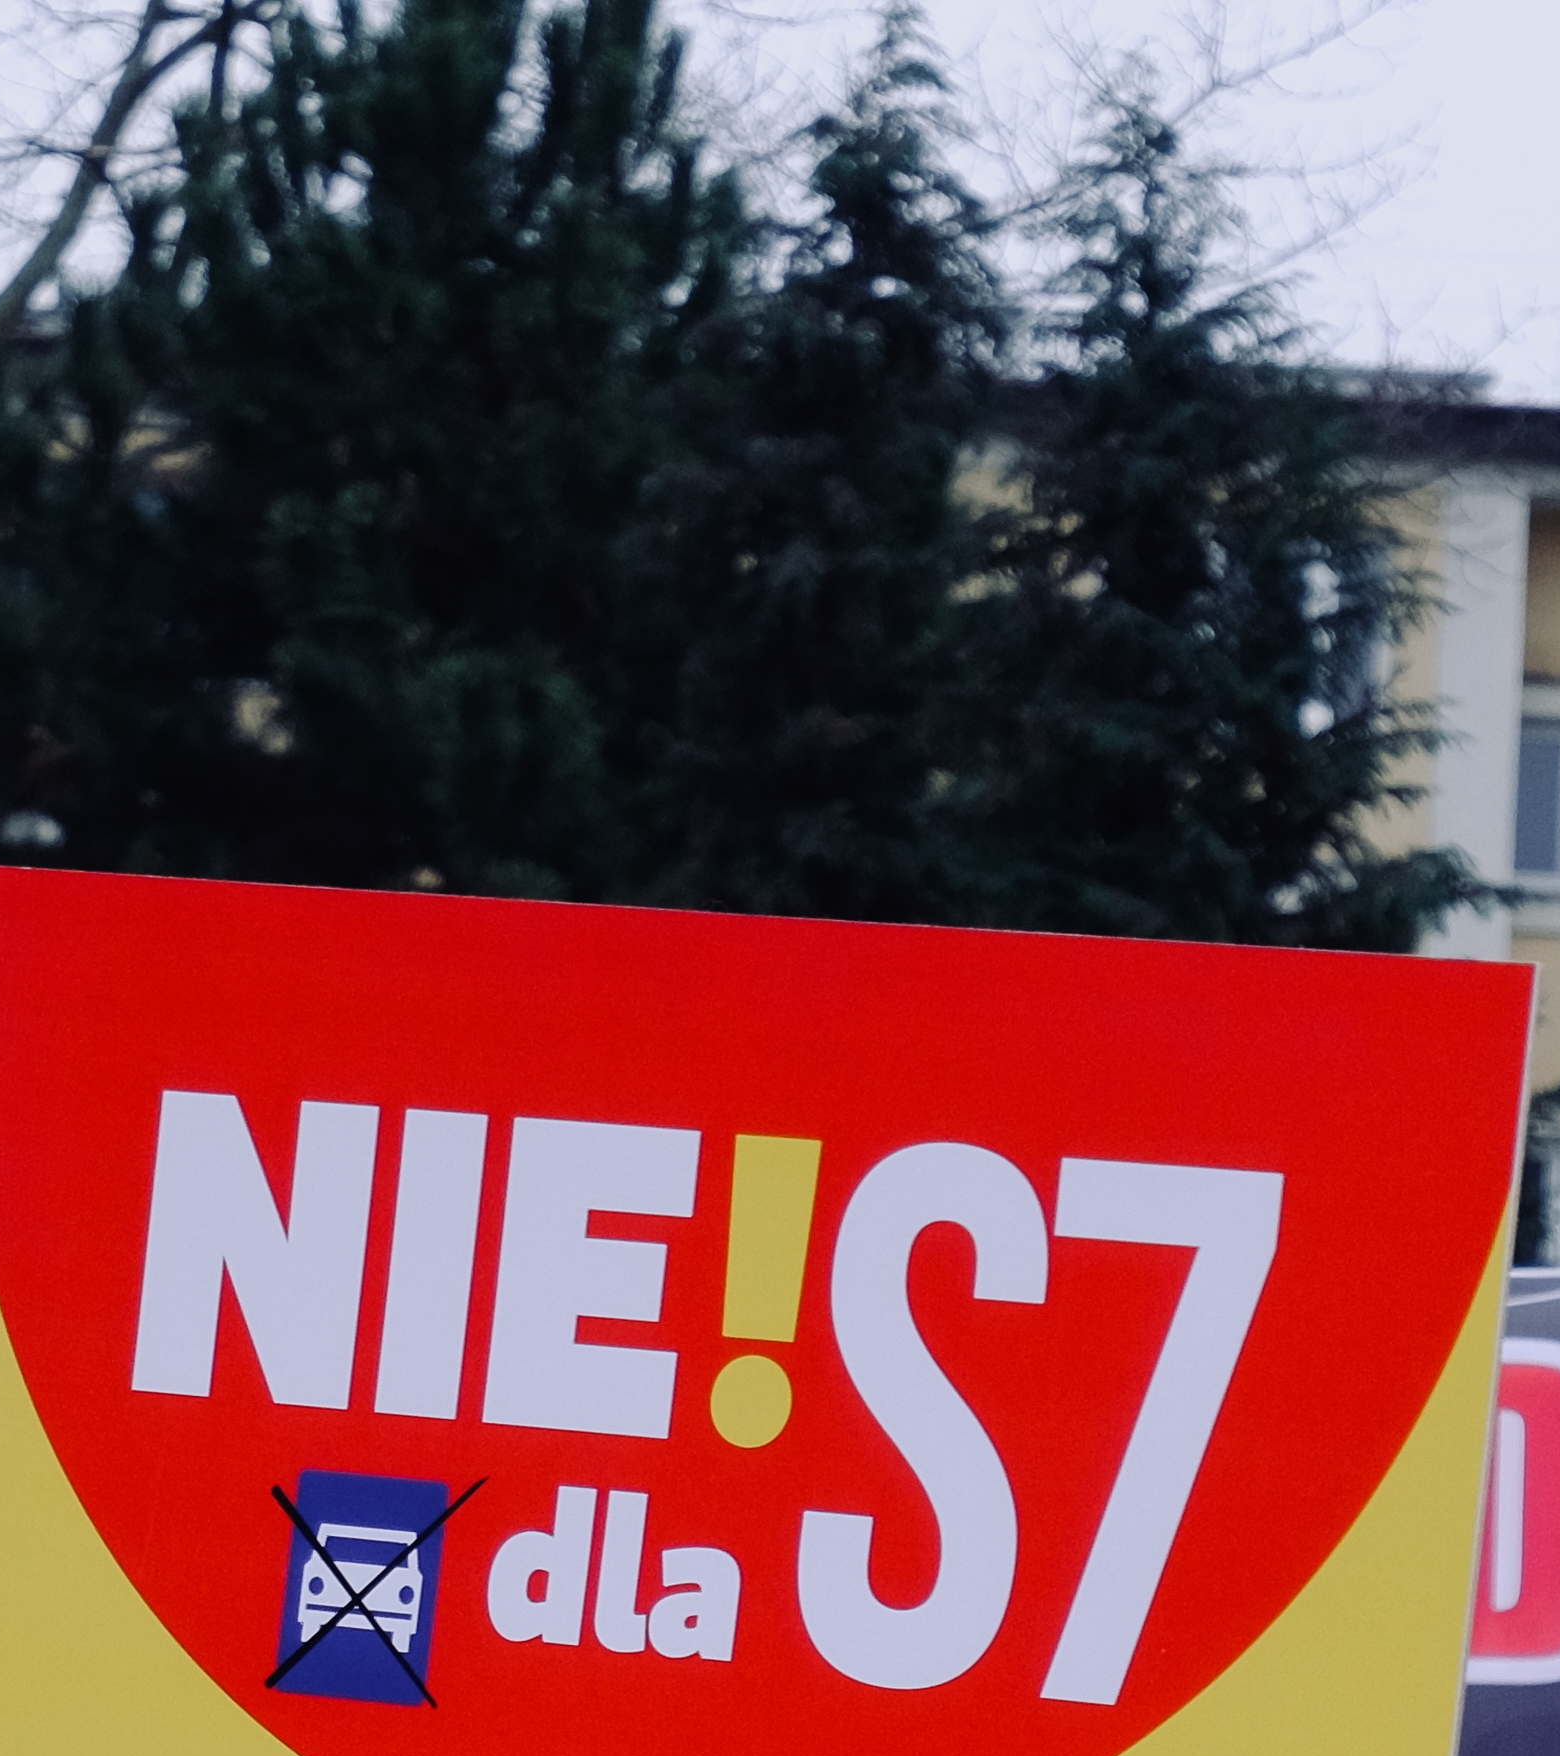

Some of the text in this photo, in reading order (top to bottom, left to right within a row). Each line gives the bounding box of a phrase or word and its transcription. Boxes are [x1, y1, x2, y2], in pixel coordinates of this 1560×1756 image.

[131, 1089, 822, 1448] NIE!
[486, 1141, 1285, 1705] dla S7
